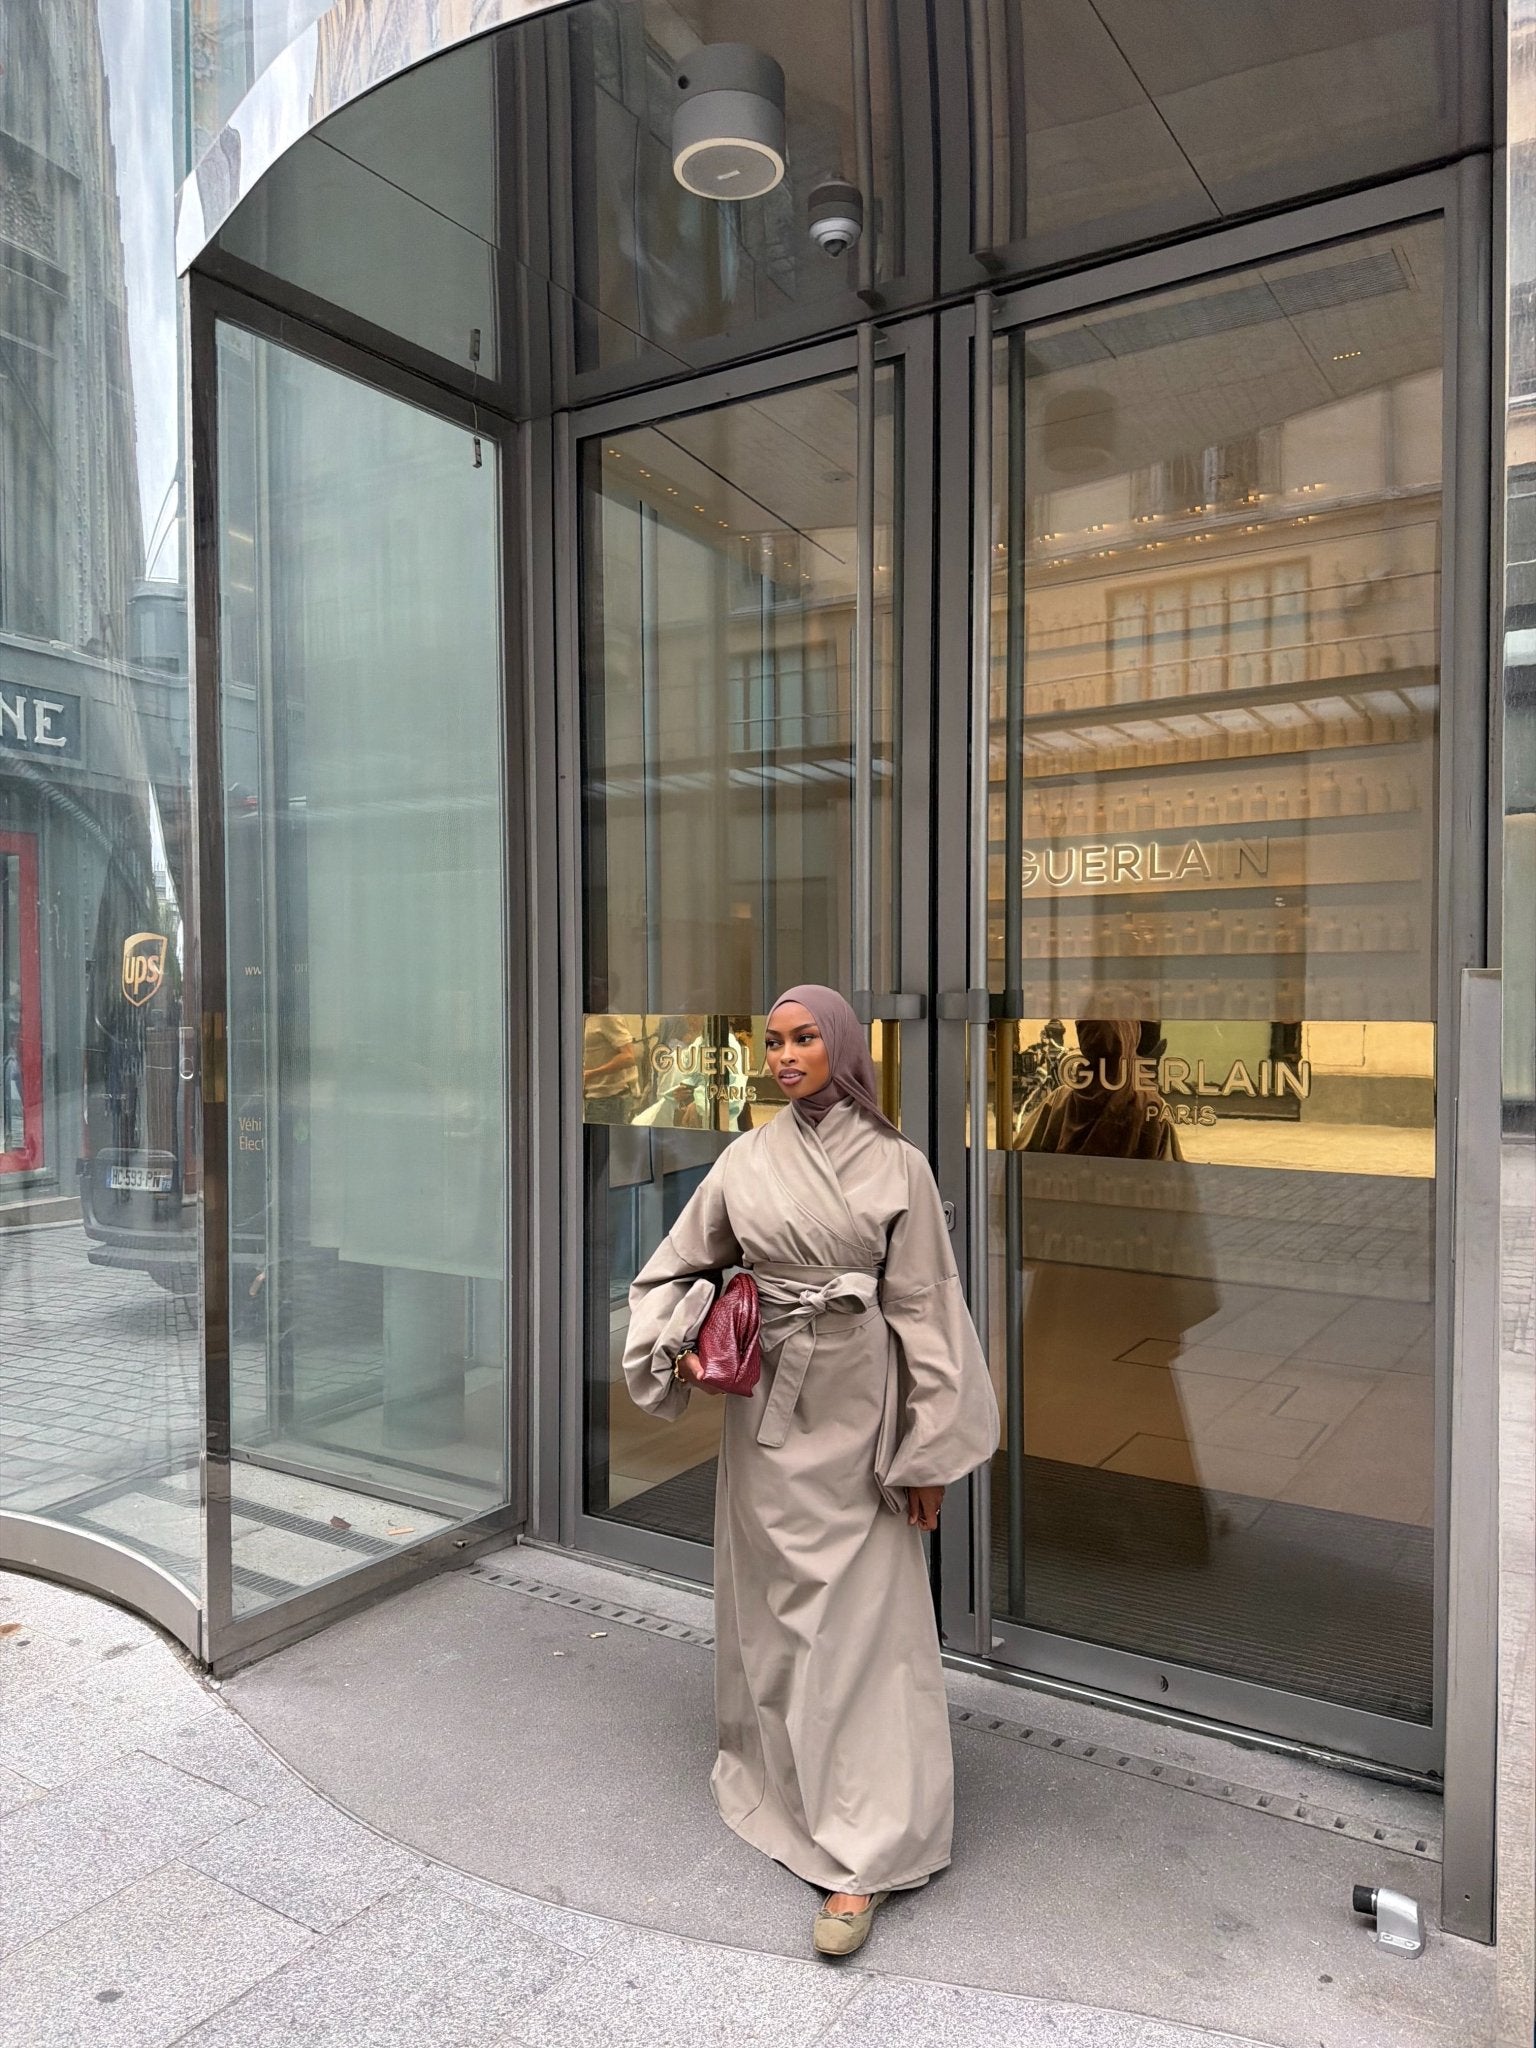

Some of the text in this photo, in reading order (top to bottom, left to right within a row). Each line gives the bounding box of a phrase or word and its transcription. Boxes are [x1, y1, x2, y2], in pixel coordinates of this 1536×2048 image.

[0, 691, 68, 748] NE
[124, 954, 161, 995] ups
[651, 1043, 769, 1077] GUERL
[1059, 1055, 1312, 1099] GUERLAIN
[707, 1084, 758, 1102] PARIS
[1145, 1103, 1217, 1127] PARIS
